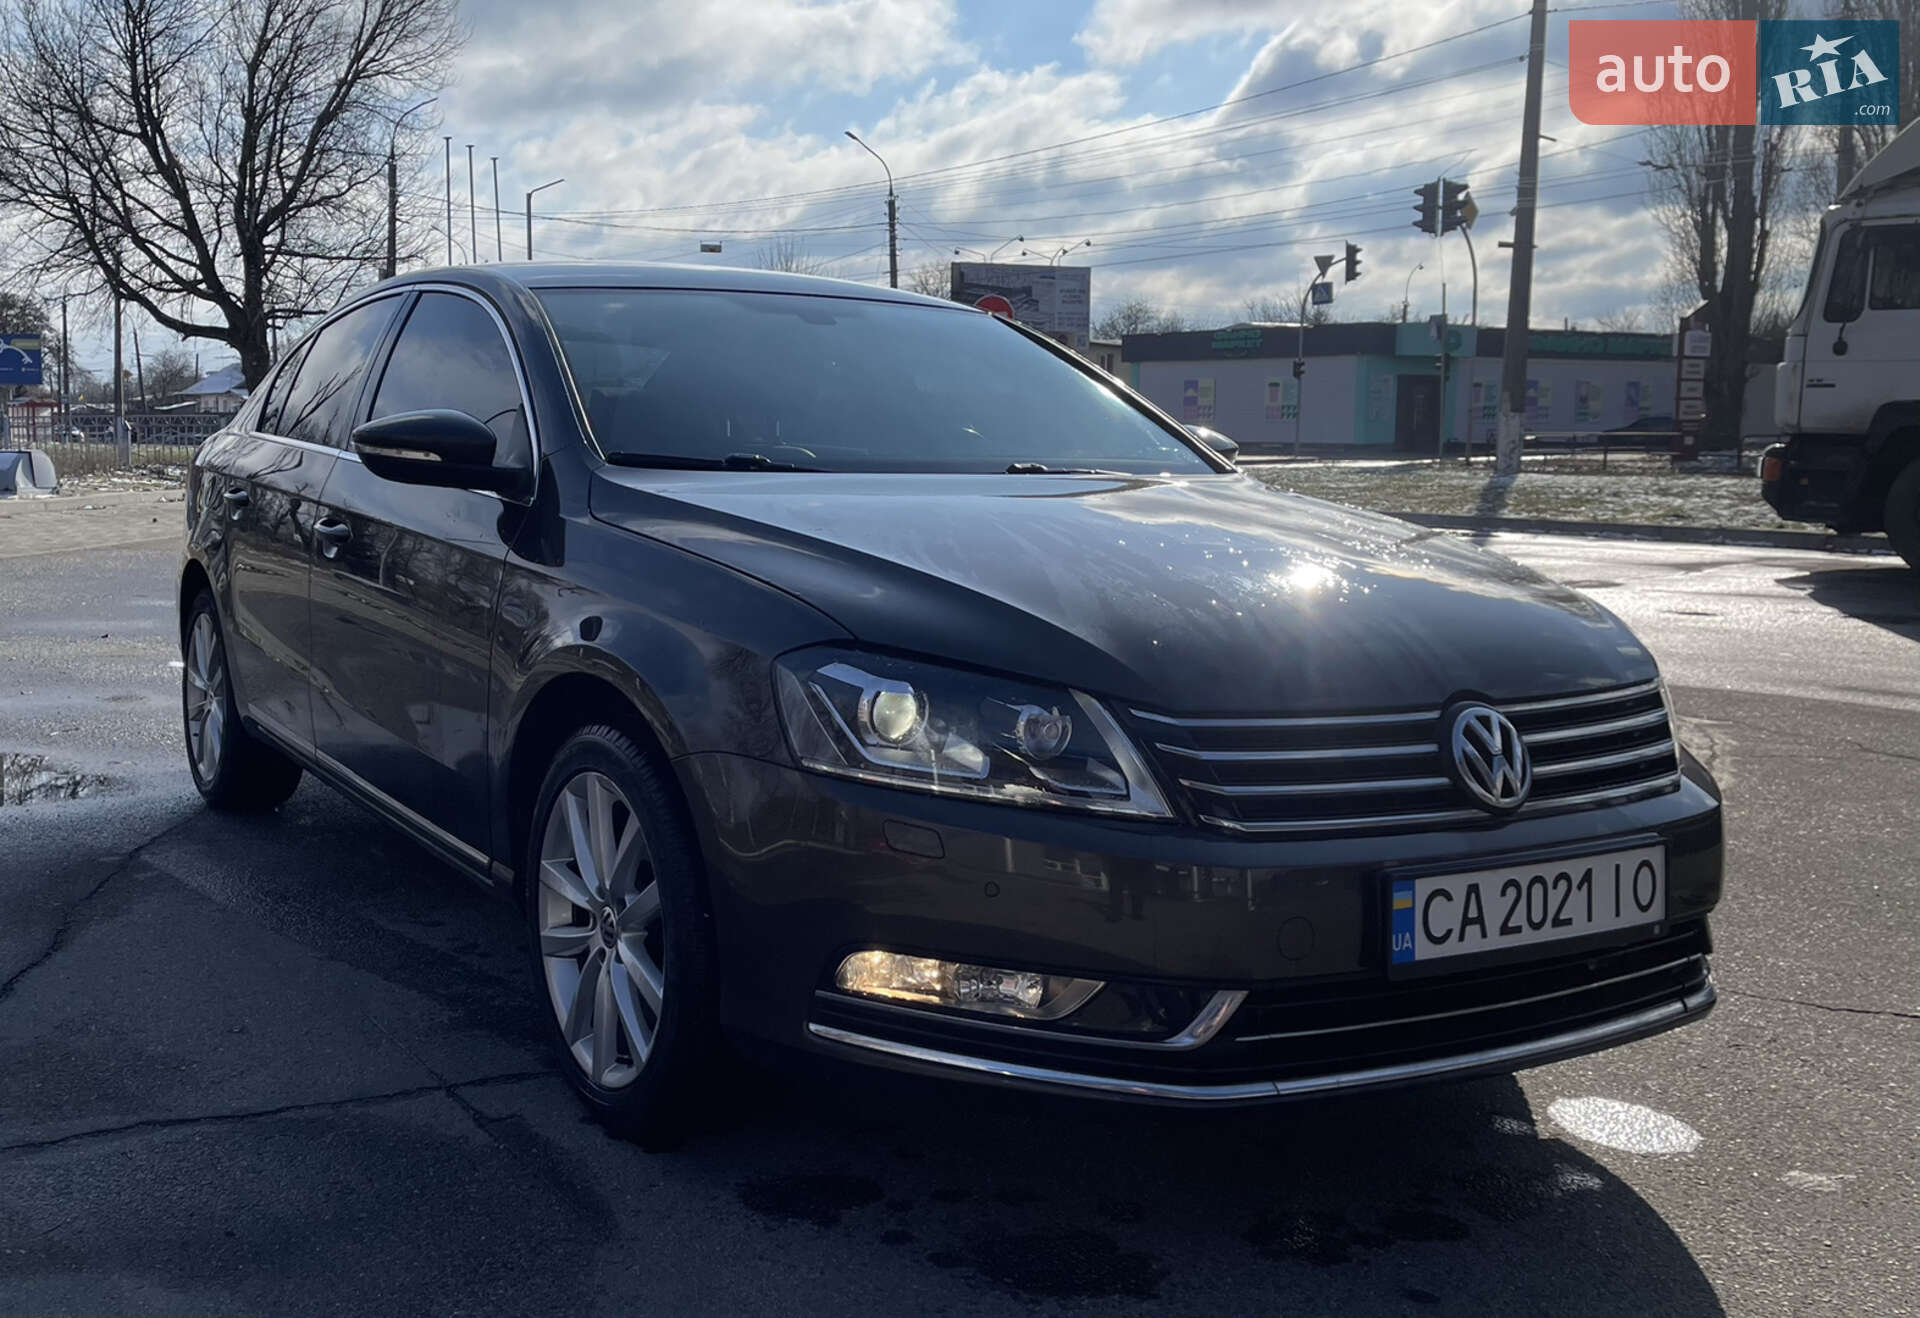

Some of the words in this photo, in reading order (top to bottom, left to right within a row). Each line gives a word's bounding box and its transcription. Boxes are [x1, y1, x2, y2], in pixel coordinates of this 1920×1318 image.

[1421, 882, 1488, 946] CA
[1499, 866, 1593, 936] 2021
[1392, 931, 1413, 952] UA
